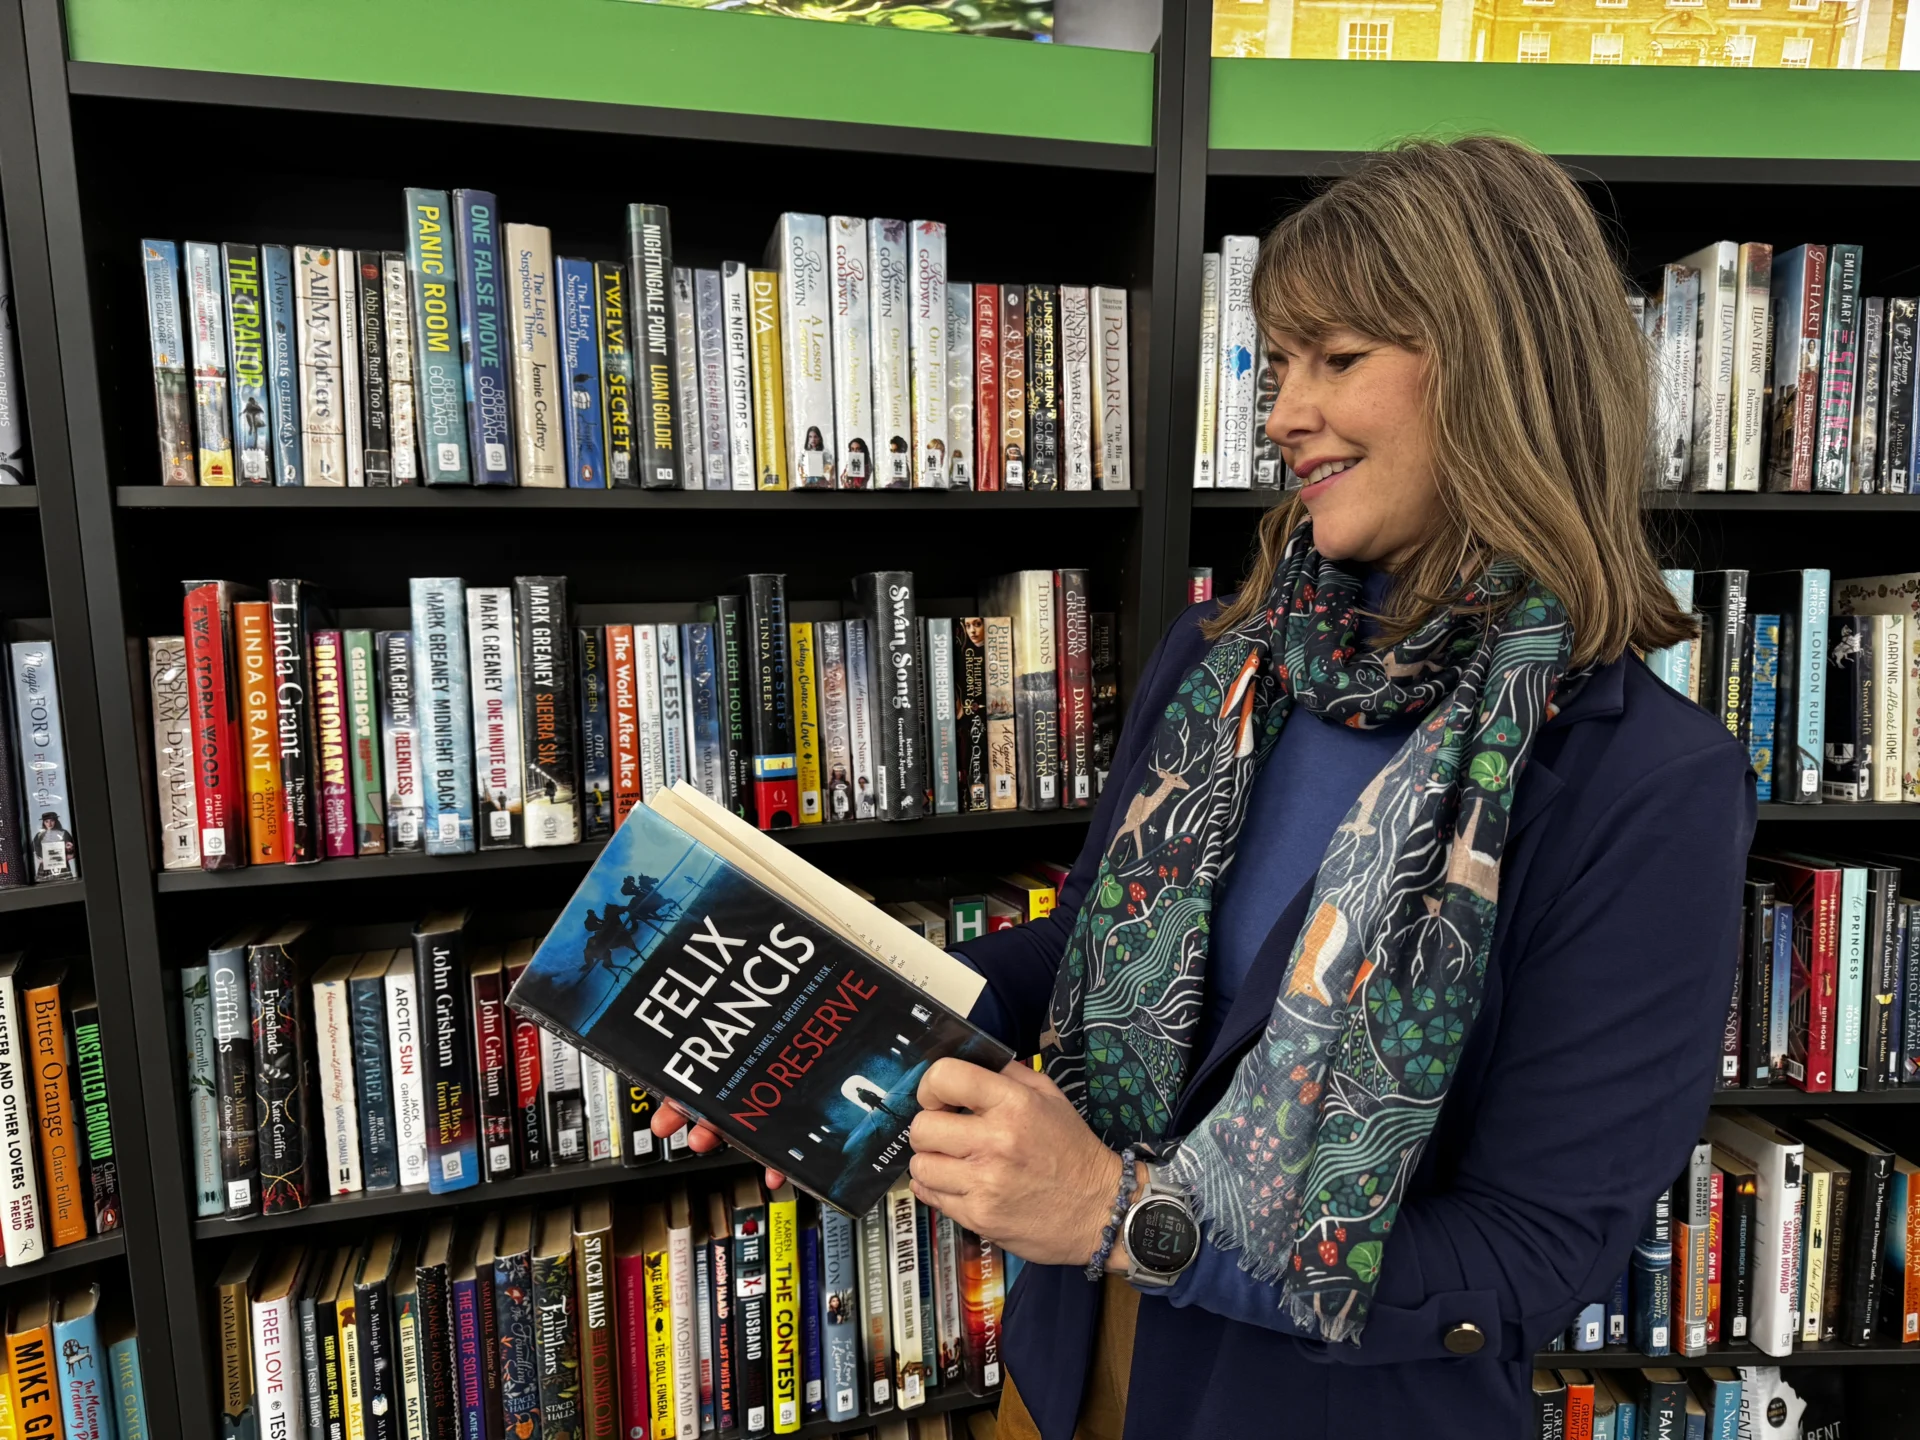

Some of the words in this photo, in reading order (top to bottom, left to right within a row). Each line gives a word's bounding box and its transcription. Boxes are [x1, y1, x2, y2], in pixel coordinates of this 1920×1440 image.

[418, 206, 444, 275] PANIC
[471, 204, 492, 244] ONE
[229, 257, 257, 296] THE
[473, 248, 494, 307] FALSE
[643, 224, 665, 314] NIGHTINGALE
[880, 247, 892, 318] GOODWIN
[919, 248, 930, 319] GOODWIN
[1229, 256, 1242, 313] HARRIS
[1842, 252, 1854, 291] EMILIA
[423, 284, 450, 352] ROOM
[755, 282, 774, 334] DIVA
[978, 295, 993, 349] KEEPING
[1840, 295, 1850, 324] HART
[232, 301, 264, 388] TRAITOR
[478, 312, 499, 368] MOVE
[648, 316, 667, 356] POINT
[532, 362, 544, 398] Jennie
[650, 364, 669, 400] LUAN
[981, 354, 993, 385] MUM
[1105, 316, 1121, 422] POLDARK
[429, 366, 448, 436] GODDARD
[1823, 351, 1854, 448] SIRENS
[534, 401, 547, 451] Godfrey
[653, 403, 672, 450] GOLDIE
[426, 592, 446, 629] MARK
[480, 594, 499, 631] MARK
[530, 586, 549, 623] MARK
[725, 611, 736, 636] The
[889, 584, 910, 651] Swan
[1038, 581, 1052, 665] TIDELANDS
[1728, 585, 1739, 636] HEPWORTH
[1738, 596, 1747, 625] SALLY
[1808, 580, 1818, 624] HERRON
[1818, 589, 1826, 616] MICK
[244, 616, 264, 685] LINDA
[272, 602, 300, 677] Linda
[389, 637, 406, 674] MARK
[532, 628, 553, 687] GREANEY
[614, 635, 626, 661] The
[759, 618, 770, 660] LINDA
[988, 624, 999, 688] GREGORY
[999, 626, 1009, 687] PHILIPPA
[1886, 633, 1898, 685] CARRYING
[429, 634, 450, 694] GREANEY
[482, 636, 502, 693] GREANEY
[726, 641, 739, 685] HIGH
[892, 652, 912, 709] Song
[934, 634, 950, 721] SPOONBENDERS
[1811, 631, 1821, 693] LONDON
[196, 655, 215, 719] STORM
[391, 675, 410, 726] GREANEY
[487, 699, 502, 719] ONE
[616, 667, 633, 709] World
[662, 675, 679, 720] LESS
[762, 667, 772, 711] GREEN
[1073, 687, 1085, 728] DARK
[1862, 680, 1872, 736] Snowdrift
[249, 691, 271, 772] GRANT
[276, 682, 303, 758] Grant
[314, 645, 344, 785] DICKTIONARY
[433, 700, 454, 763] MIDNIGHT
[536, 694, 555, 741] SIERRA
[618, 714, 633, 749] After
[729, 688, 742, 740] HOUSE
[1809, 701, 1819, 745] RULES
[1886, 687, 1899, 733] Albert
[200, 724, 220, 788] WOOD
[488, 723, 506, 765] MINUTE
[539, 743, 556, 765] SIX
[1034, 710, 1047, 778] GREGORY
[1074, 732, 1087, 776] TIDES
[1886, 733, 1897, 760] HOME
[437, 767, 456, 811] BLACK
[490, 769, 507, 789] OUT
[620, 752, 635, 788] Alice
[204, 798, 214, 825] GRAY
[213, 794, 224, 827] PHILIP
[1819, 899, 1827, 953] BALLROOM
[432, 947, 449, 990] John
[633, 915, 747, 1039] FELIX
[34, 997, 58, 1056] Bitter
[214, 968, 233, 1053] Griffiths
[261, 988, 279, 1055] Fyneshade
[395, 987, 411, 1043] ARCTIC
[479, 1000, 499, 1029] John
[663, 921, 816, 1094] FRANCIS
[1844, 1005, 1853, 1046] HOLDEN
[1852, 1006, 1860, 1044] WENDY
[433, 995, 453, 1068] Grisham
[716, 1087, 730, 1100] THE
[726, 1066, 748, 1089] HIGHER
[744, 1054, 758, 1068] THE
[754, 1034, 777, 1056] STAKES,
[772, 1020, 786, 1034] THE
[782, 994, 808, 1022] GREATER
[804, 981, 818, 995] THE
[729, 1083, 781, 1132] NO
[778, 969, 879, 1090] RESERVE
[76, 1023, 106, 1102] UNSETTLED
[399, 1045, 414, 1075] SUN
[484, 1034, 503, 1097] Grisham
[516, 1022, 536, 1093] Grisham
[42, 1062, 63, 1138] Orange
[271, 1100, 282, 1122] Kate
[86, 1102, 113, 1160] GROUND
[273, 1124, 286, 1159] Griffin
[872, 1163, 883, 1172] A
[879, 1141, 902, 1164] DICK
[898, 1125, 910, 1143] FR
[51, 1145, 67, 1178] Claire
[10, 1199, 22, 1231] FREUD
[21, 1193, 34, 1231] ESTHER
[55, 1178, 72, 1220] Fuller
[1656, 1204, 1669, 1217] AND
[673, 1238, 686, 1264] EXIT
[742, 1238, 758, 1262] THE
[774, 1212, 784, 1261] HAMILTON
[783, 1218, 792, 1252] KAREN
[1142, 1238, 1153, 1248] 23
[1144, 1228, 1155, 1237] 53
[1158, 1231, 1181, 1254] 12
[1175, 1224, 1186, 1233] 10
[1656, 1227, 1668, 1240] DAY
[1782, 1220, 1792, 1256] SANDRA
[584, 1238, 603, 1289] STACEY
[1696, 1232, 1705, 1274] TRIGGER
[674, 1267, 688, 1306] WEST
[776, 1262, 794, 1303] THE
[1654, 1274, 1662, 1319] HOROWITZ
[1695, 1278, 1704, 1317] MORTIS
[1780, 1258, 1791, 1294] HOWARD
[262, 1308, 280, 1347] FREE
[588, 1291, 606, 1329] HALLS
[745, 1301, 762, 1360] HUSBAND
[676, 1318, 691, 1369] MOHSIN
[776, 1310, 795, 1401] CONTEST
[14, 1340, 50, 1408] MIKE
[266, 1351, 283, 1394] LOVE
[681, 1372, 692, 1417] HAMID
[545, 1401, 575, 1413] STACEY
[547, 1408, 576, 1421] HALLS
